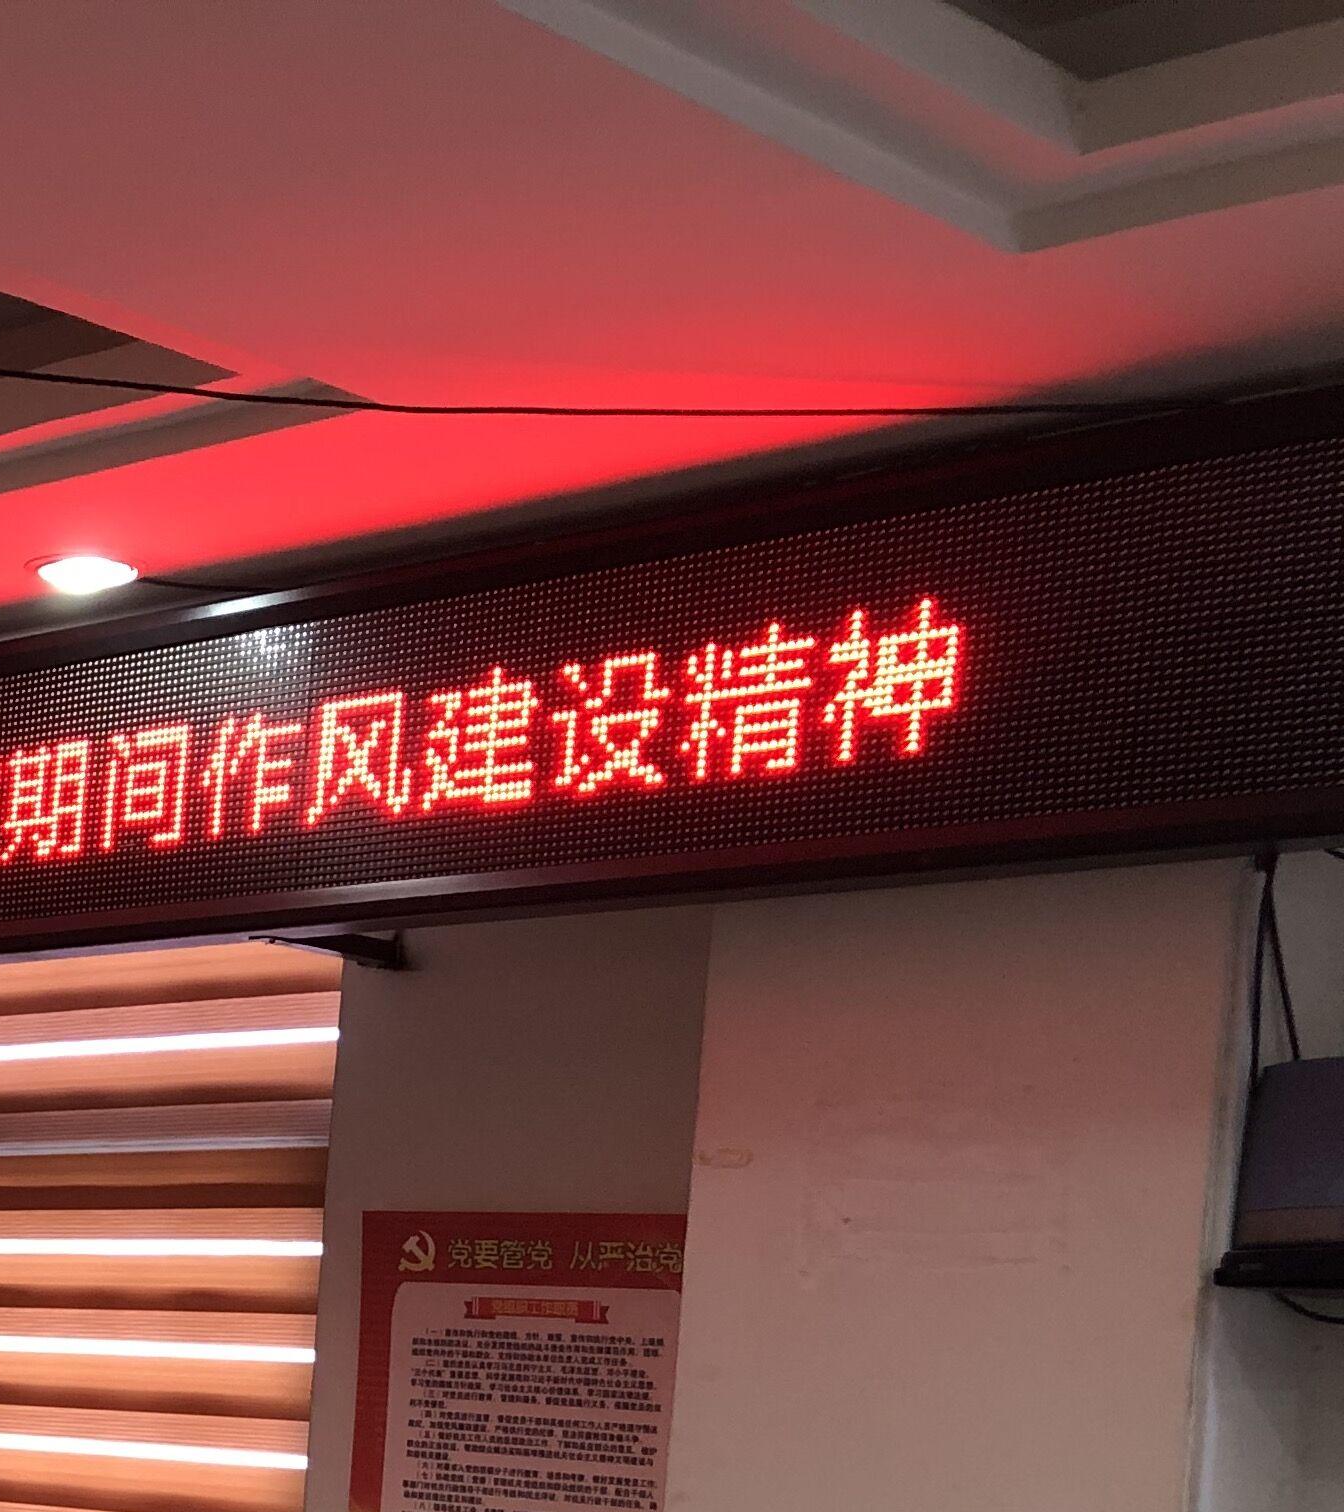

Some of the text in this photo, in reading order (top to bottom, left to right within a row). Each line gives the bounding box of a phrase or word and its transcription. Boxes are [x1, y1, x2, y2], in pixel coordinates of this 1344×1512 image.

[448, 1239, 683, 1273] 党要管党 从严治党
